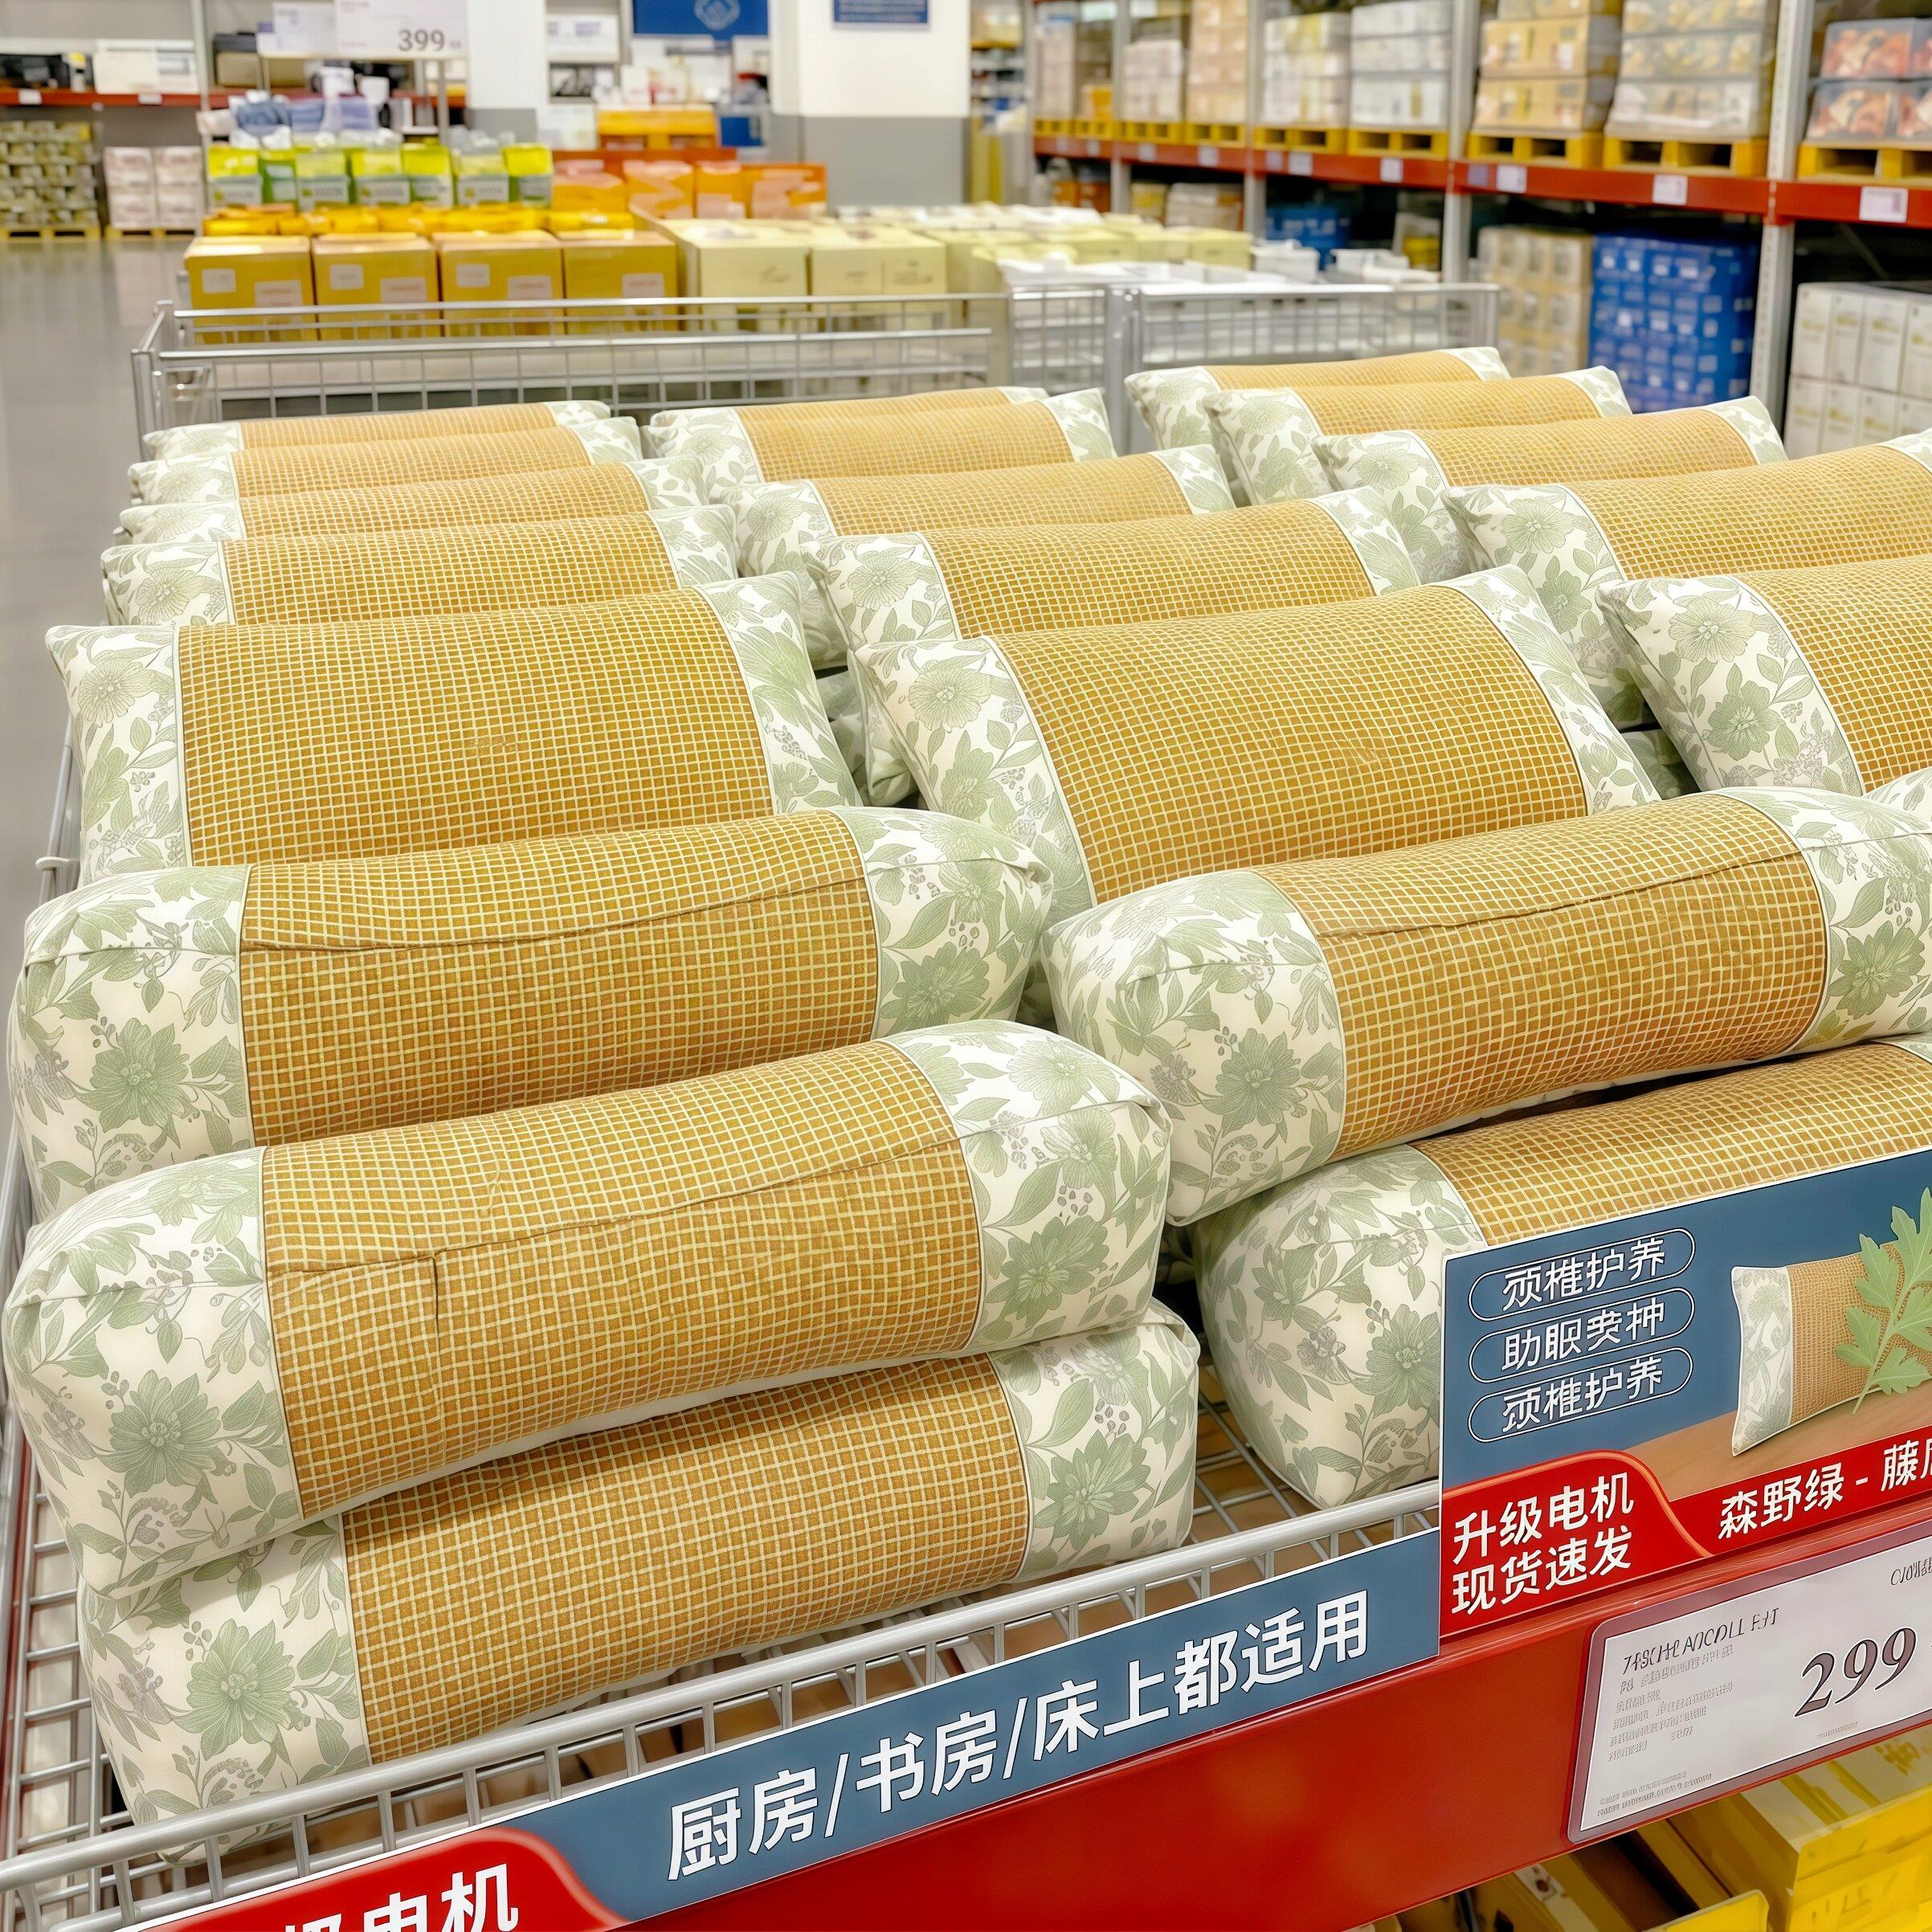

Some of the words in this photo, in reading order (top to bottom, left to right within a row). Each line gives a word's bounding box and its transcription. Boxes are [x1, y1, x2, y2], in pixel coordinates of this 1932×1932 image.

[398, 29, 446, 51] 399
[1452, 1472, 1634, 1565] 升级电机
[1718, 1462, 1844, 1539] 森野绿
[1451, 1525, 1632, 1615] 现货速发
[1795, 1628, 1917, 1718] 299
[667, 1589, 1369, 1881] 厨房/书房/床上都适用
